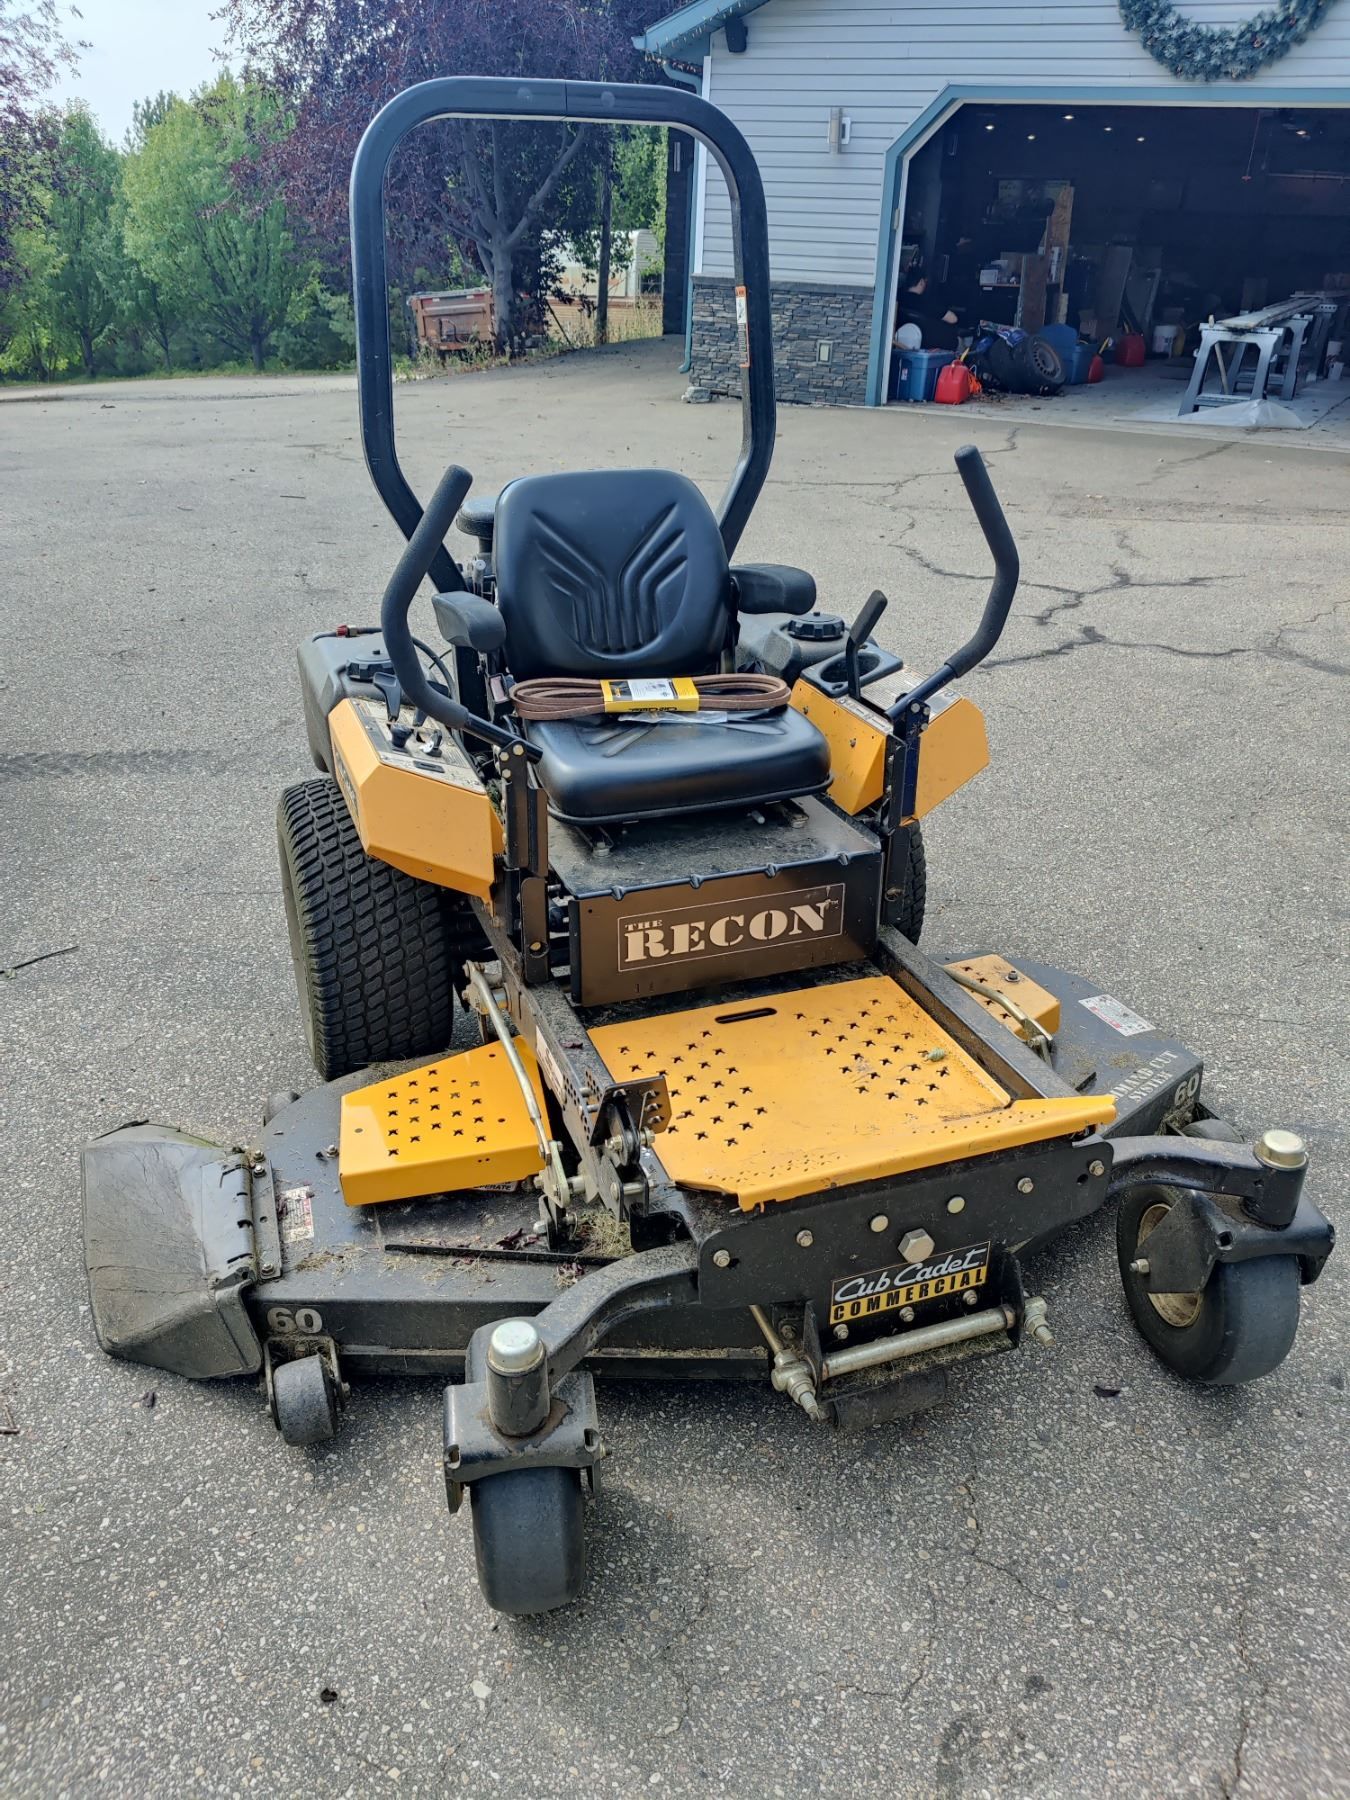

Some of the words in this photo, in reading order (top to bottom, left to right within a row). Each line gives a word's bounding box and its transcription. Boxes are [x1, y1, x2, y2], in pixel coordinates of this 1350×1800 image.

[624, 919, 663, 931] THE
[624, 899, 831, 963] RECON
[1149, 1050, 1178, 1069] CUT
[1174, 1072, 1200, 1107] 60
[834, 1272, 891, 1302] Cub
[893, 1248, 987, 1287] Cadet
[833, 1268, 983, 1321] COMMERCIAL
[267, 1307, 323, 1334] 60
